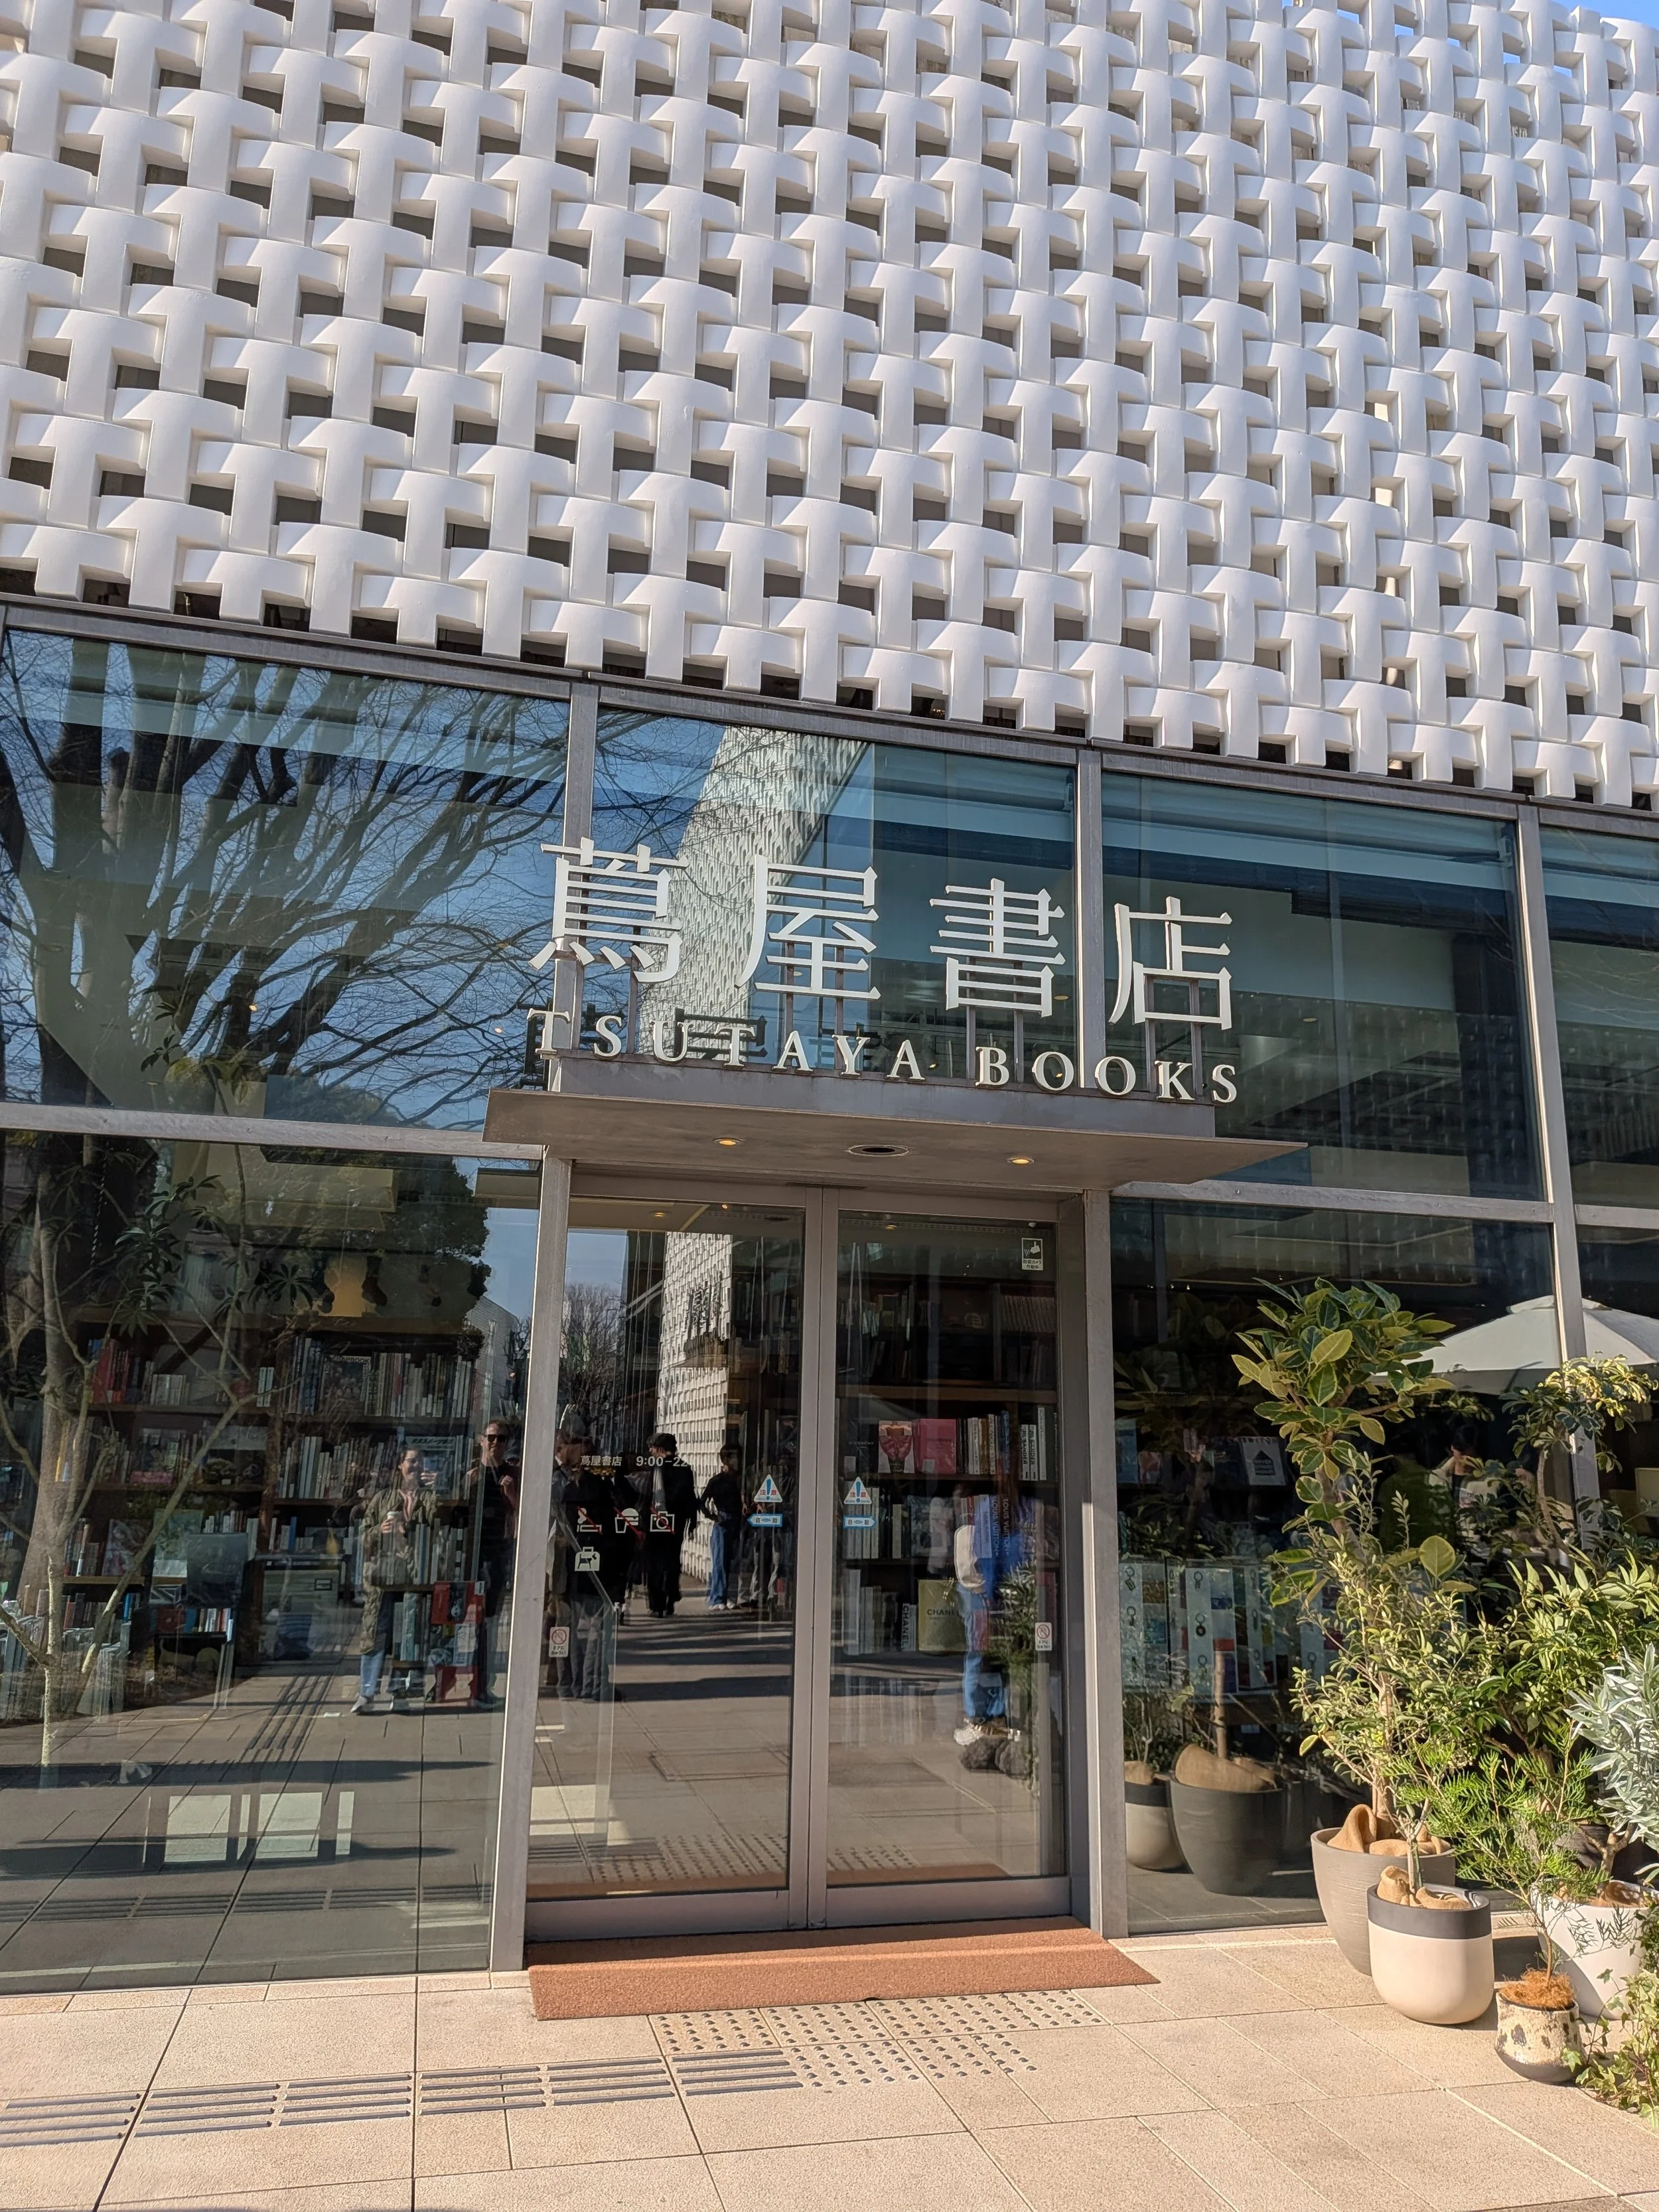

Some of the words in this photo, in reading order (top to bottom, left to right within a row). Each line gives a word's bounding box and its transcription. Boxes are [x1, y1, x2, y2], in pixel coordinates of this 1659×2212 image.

[529, 837, 1233, 1030] 蔦屋書店
[527, 1007, 926, 1082] TSUTAYA
[975, 1046, 1238, 1104] BOOKS
